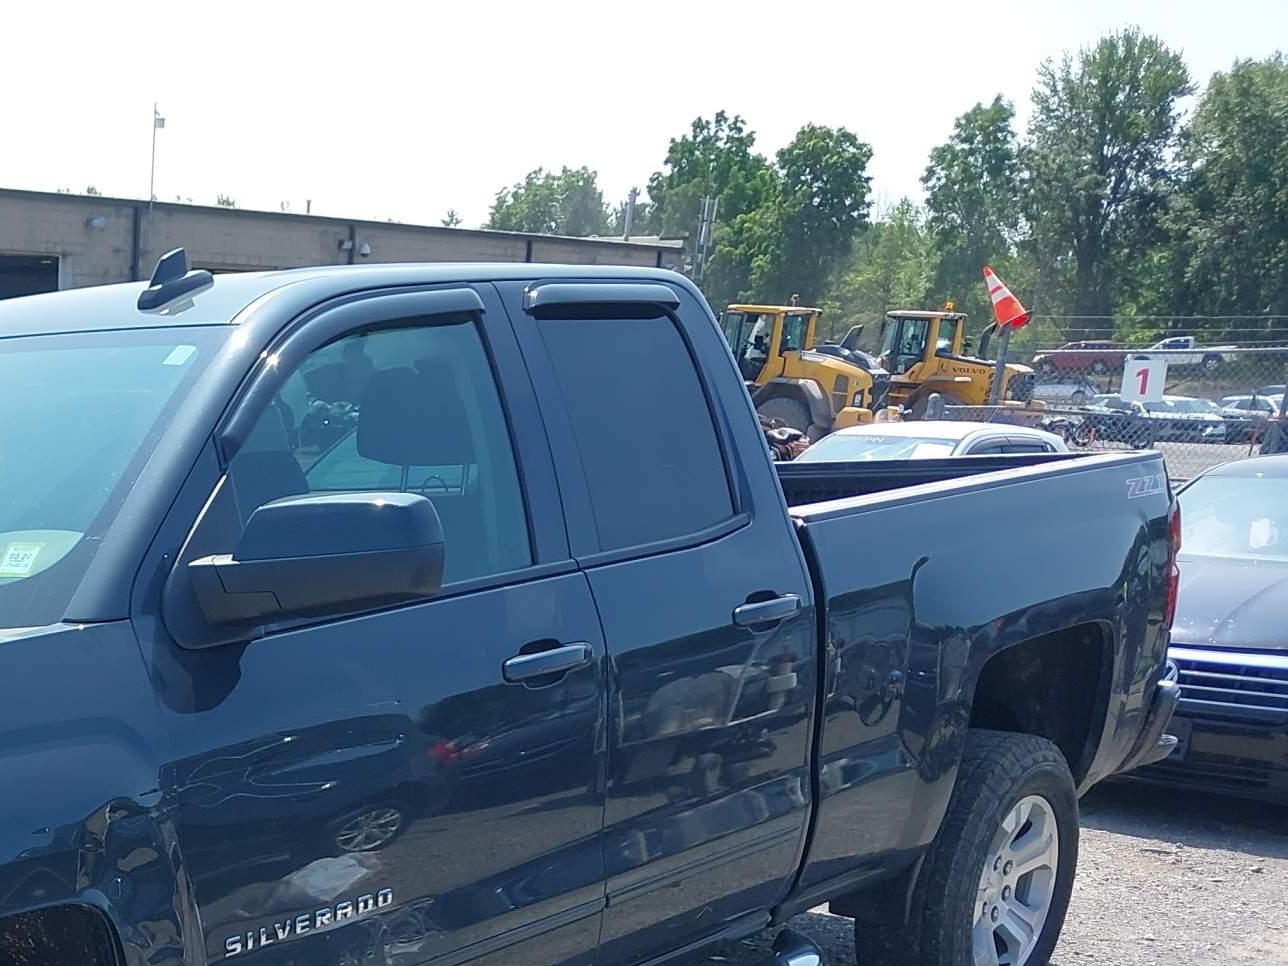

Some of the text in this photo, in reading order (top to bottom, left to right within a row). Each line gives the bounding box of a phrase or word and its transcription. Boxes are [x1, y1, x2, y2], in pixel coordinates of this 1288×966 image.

[952, 367, 986, 375] VOLVO
[1136, 367, 1149, 395] 1
[224, 887, 394, 958] SILVERADO
